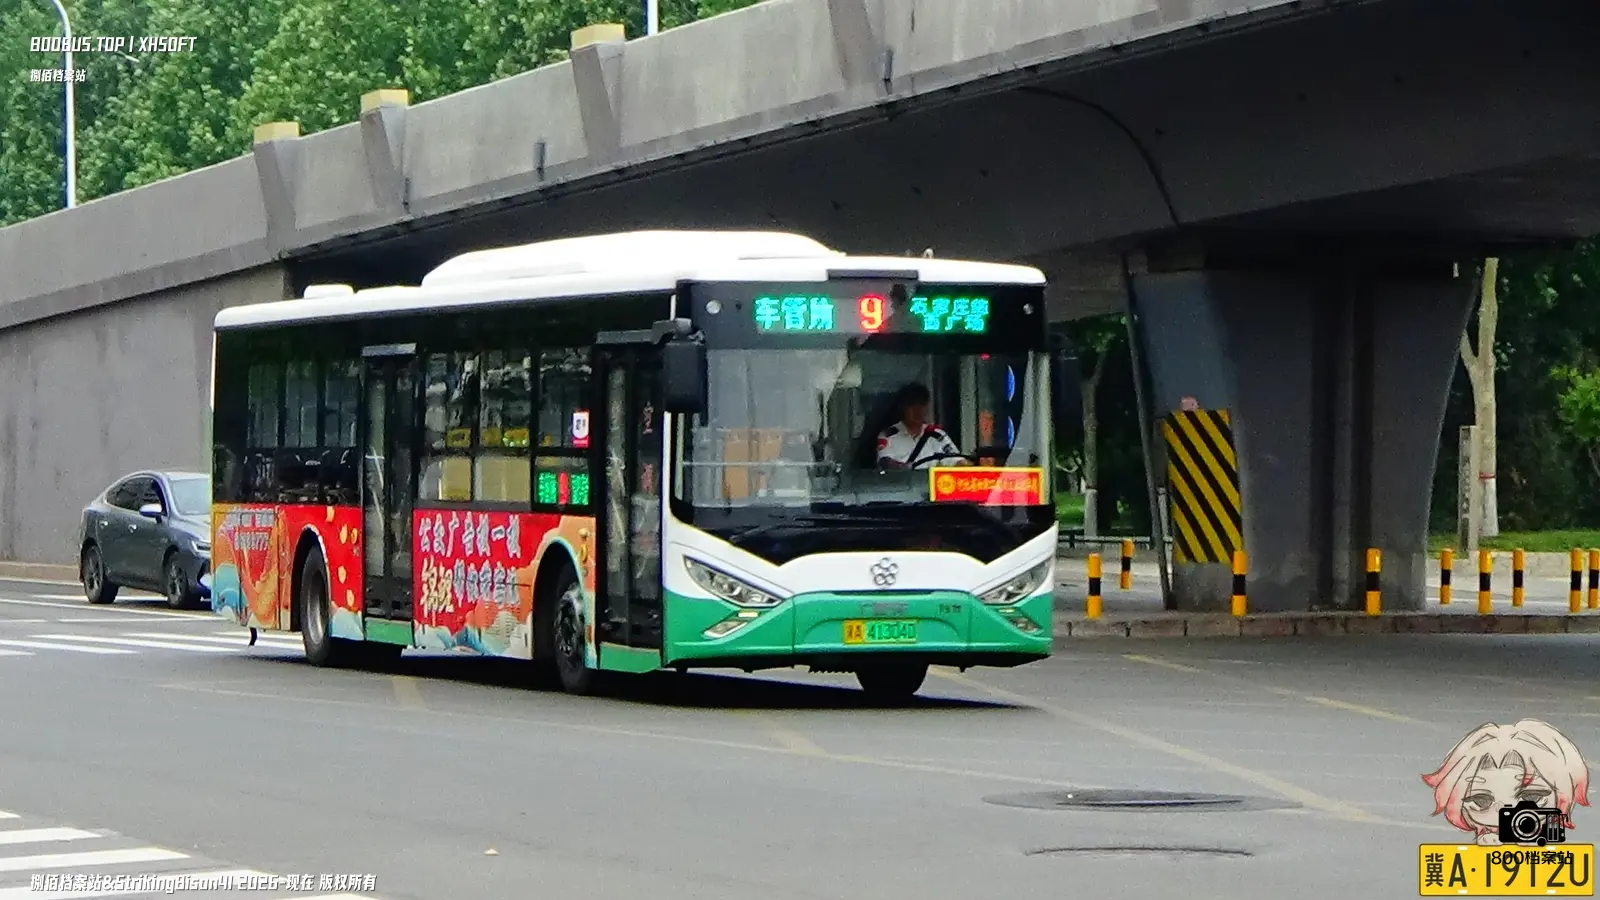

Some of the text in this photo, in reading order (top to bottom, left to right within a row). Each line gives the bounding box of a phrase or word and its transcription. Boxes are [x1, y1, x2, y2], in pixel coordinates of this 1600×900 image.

[754, 296, 834, 331] 车管所
[858, 296, 884, 331] 9
